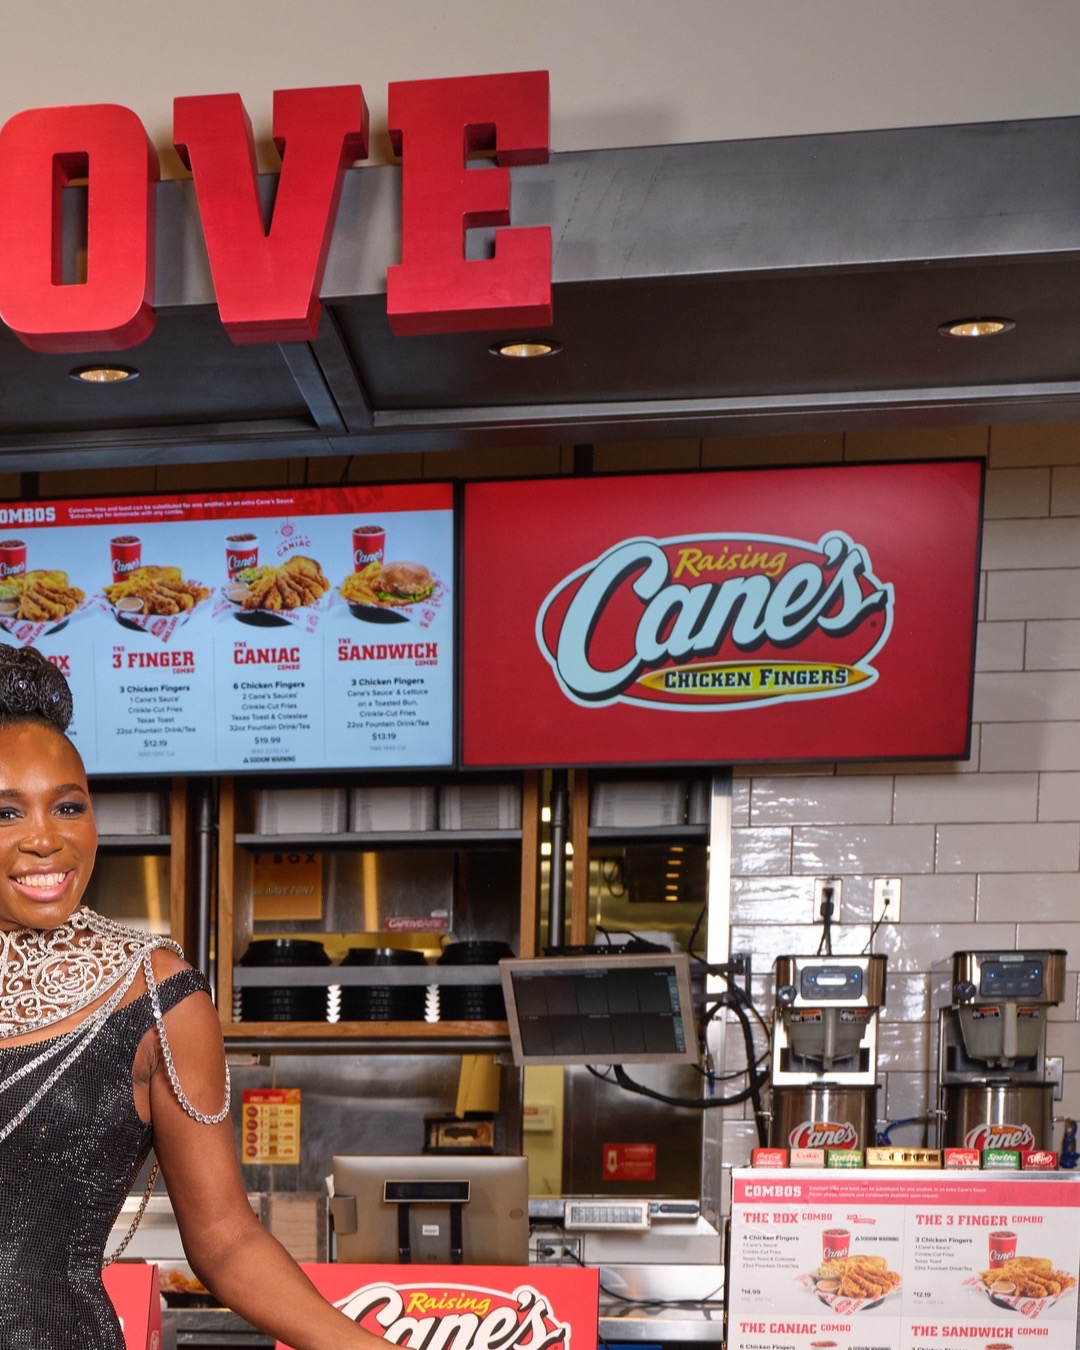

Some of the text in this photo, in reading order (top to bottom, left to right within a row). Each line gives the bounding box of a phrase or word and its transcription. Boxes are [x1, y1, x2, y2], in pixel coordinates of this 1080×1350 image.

[674, 546, 787, 578] Raising
[557, 537, 887, 701] Cane's
[234, 647, 300, 664] CANIAC
[338, 643, 438, 661] SANDWICH
[113, 651, 195, 668] 3 FINGER
[359, 678, 391, 686] Chicken
[394, 678, 424, 686] Fingers
[664, 667, 846, 689] CHICKEN FINGERS
[161, 685, 190, 693] Fingers
[241, 682, 273, 690] Chicken
[275, 681, 305, 690] Fingers
[360, 710, 398, 718] Crinkle-Cut
[790, 1121, 858, 1150] Cane's
[966, 1124, 1035, 1150] Cane's
[828, 1154, 862, 1163] Sprite
[988, 1153, 1017, 1162] Sprite
[744, 1185, 802, 1197] COMBOS
[743, 1212, 833, 1223] THE BOX COMBO
[916, 1215, 942, 1225] THE
[947, 1215, 954, 1225] 3
[958, 1215, 1008, 1226] FINGER
[407, 1292, 492, 1314] Raising
[740, 1323, 851, 1334] THE CANIAC COMBO
[912, 1326, 938, 1336] THE
[942, 1326, 1013, 1338] SANDWICH
